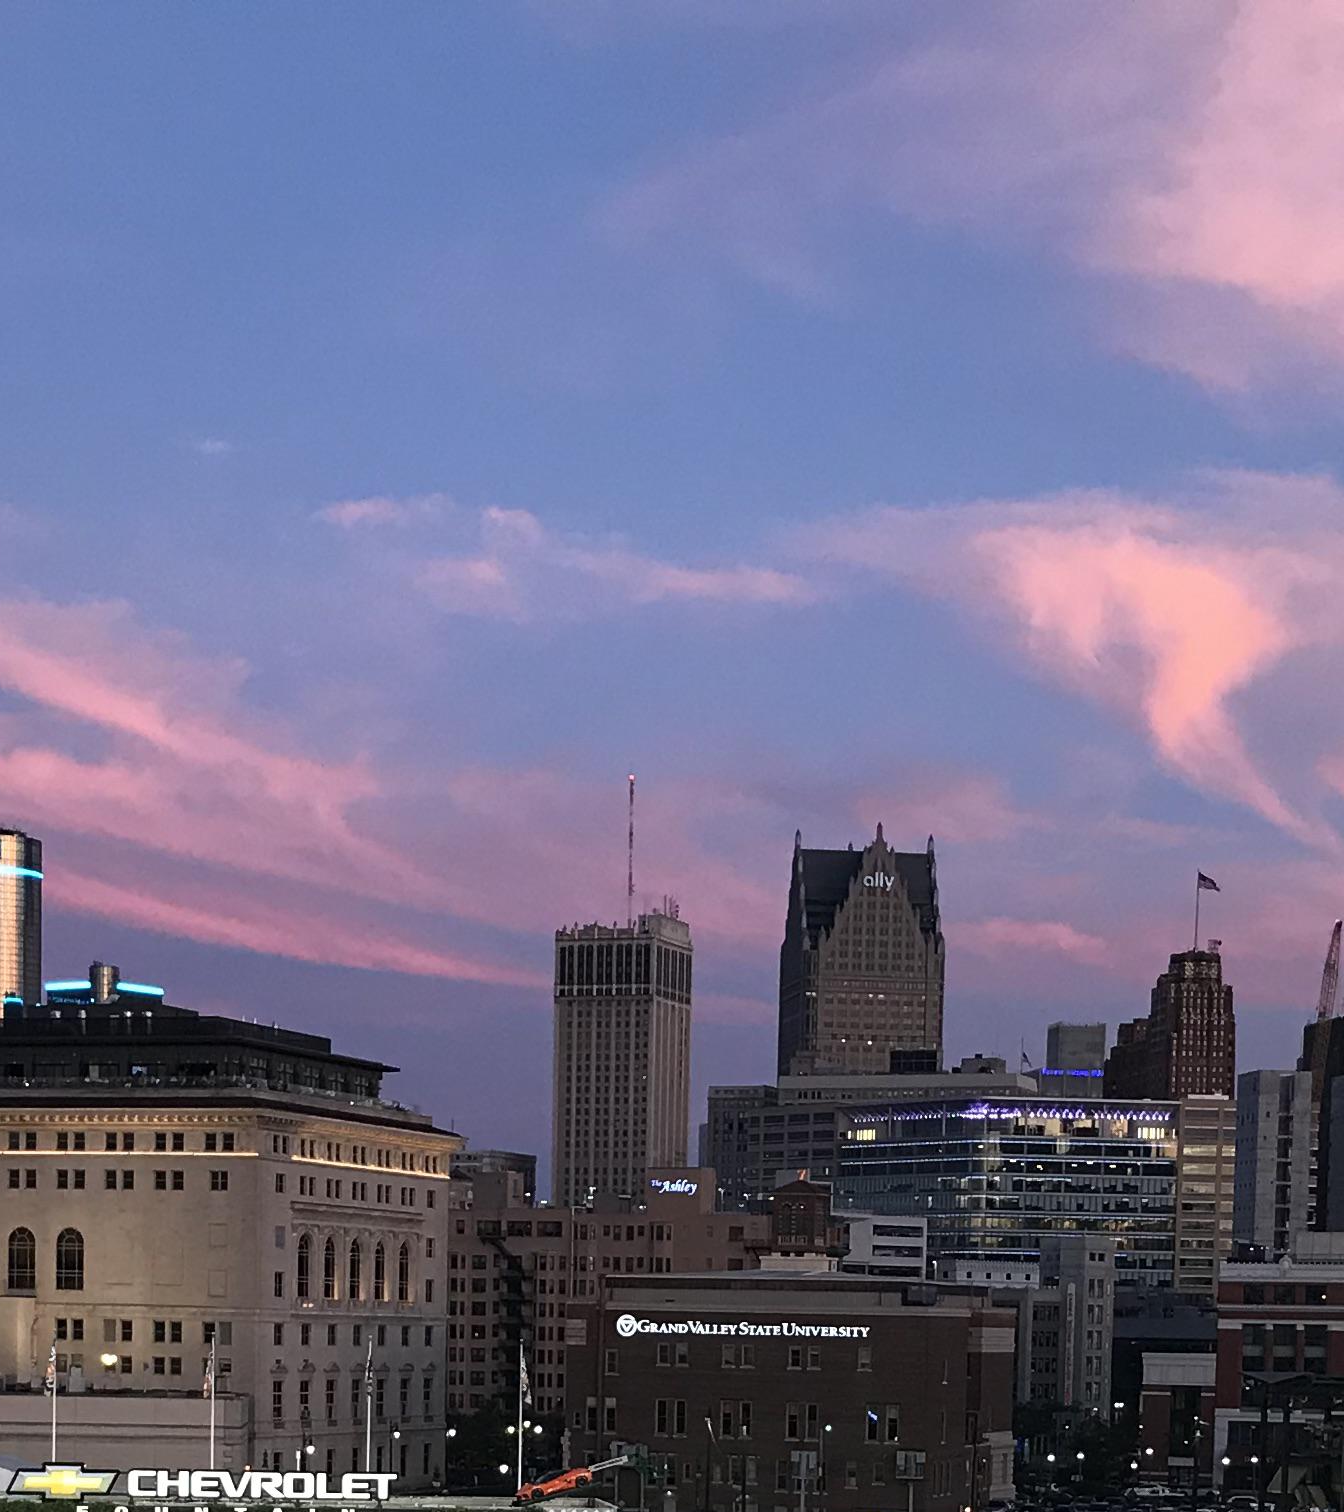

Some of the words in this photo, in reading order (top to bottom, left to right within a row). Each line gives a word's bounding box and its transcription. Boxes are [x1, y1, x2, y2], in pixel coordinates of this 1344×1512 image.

[659, 1179, 698, 1196] Ashley
[636, 1319, 689, 1335] GRAND
[687, 1320, 738, 1336] VALLEY
[738, 1322, 783, 1337] STATE
[782, 1322, 871, 1338] UNIVERSITY
[127, 1469, 398, 1500] CHEVROLET
